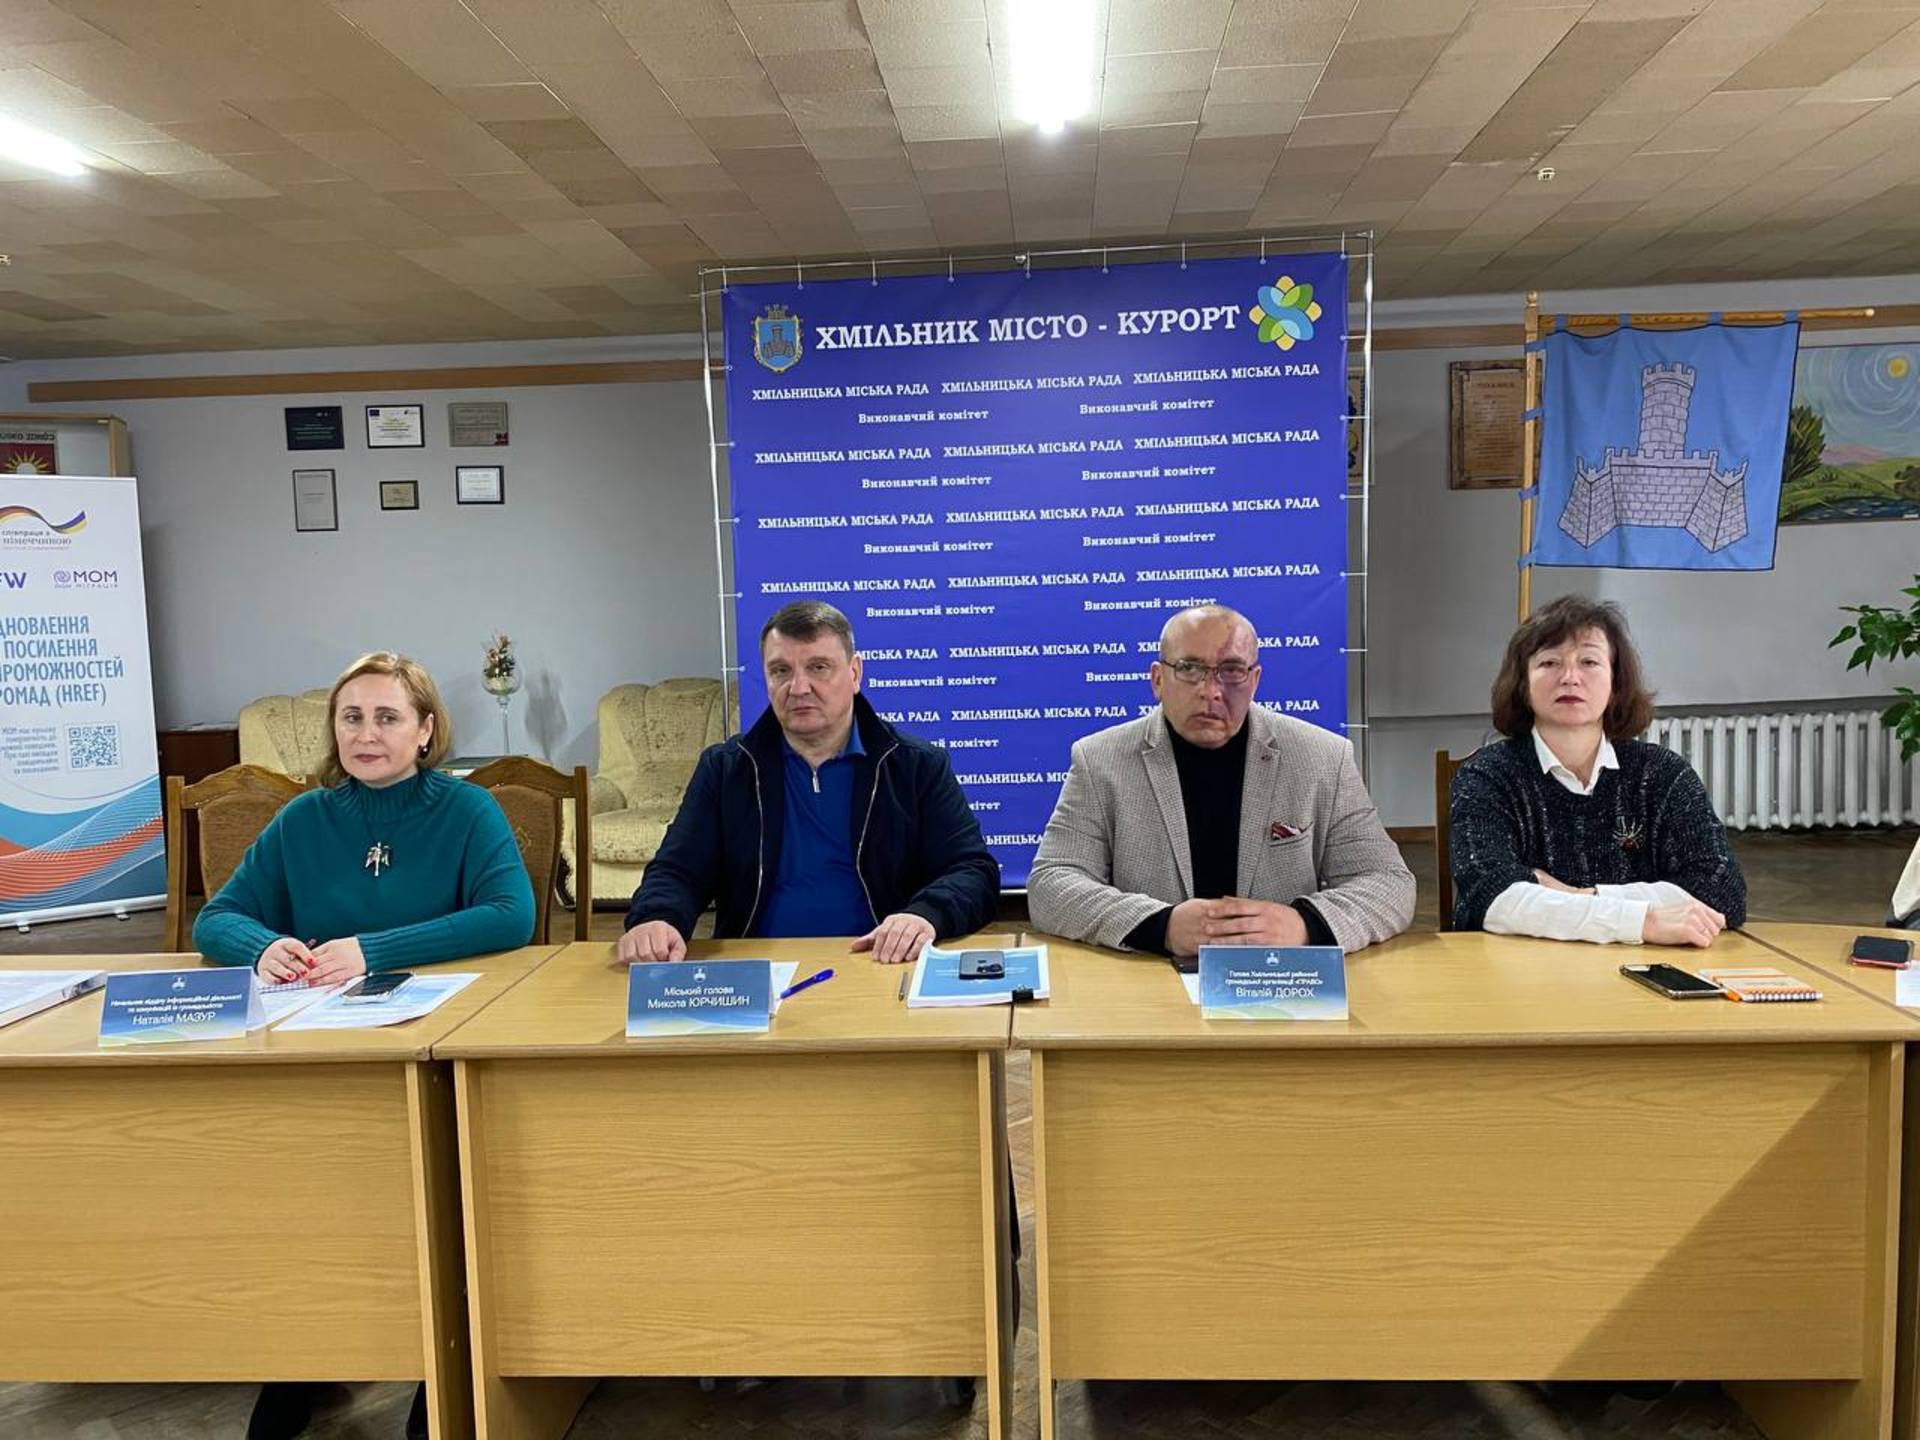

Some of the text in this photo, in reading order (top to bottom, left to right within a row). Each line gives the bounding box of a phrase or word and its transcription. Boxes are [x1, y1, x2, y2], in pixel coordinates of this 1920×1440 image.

[816, 320, 979, 349] ХМІЛЬНИК
[988, 315, 1087, 341] МІСТО
[1118, 305, 1240, 335] КУРОРТ
[1133, 364, 1319, 384] ХМІЛЬНИЦЬКА МІСЬКА РАДА
[942, 375, 1122, 393] ХМІЛЬНИЦЬКА МІСЬКА РАДА
[752, 384, 929, 400] ХМІЛЬНИЦЬКА МІСЬКА РАДА
[1080, 398, 1214, 414] Виконавчий комітет
[859, 409, 988, 423] Виконавчий комітет
[1134, 430, 1320, 449] ХМІЛЬНИЦЬКА МІСЬКА РАДА
[944, 440, 1123, 457] ХМІЛЬНИЦЬКА МІСЬКА РАДА
[755, 448, 931, 464] ХМІЛЬНИЦЬКА МІСЬКА РАДА
[1082, 465, 1216, 480] Виконавчий комітет
[862, 475, 991, 488] Виконавчий комітет
[1136, 497, 1320, 516] ХМІЛЬНИЦЬКА МІСЬКА РАДА
[758, 513, 933, 528] ХМІЛЬНИЦЬКА МІСЬКА РАДА
[946, 506, 1124, 523] ХМІЛЬНИЦЬКА МІСЬКА РАДА
[1083, 532, 1215, 546] Виконавчий комітет
[864, 541, 993, 553] Виконавчий комітет
[73, 571, 118, 583] МОМ
[1136, 564, 1320, 581] ХМІЛЬНИЦЬКА МІСЬКА РАДА
[0, 572, 27, 588] W
[761, 579, 936, 593] ХМІЛЬНИЦЬКА МІСЬКА РАДА
[948, 572, 1125, 588] ХМІЛЬНИЦЬКА МІСЬКА РАДА
[867, 604, 995, 617] Виконавчий комітет
[1084, 598, 1161, 610] Виконавчий
[4, 638, 98, 659] ПОСИЛЕННЯ
[1257, 635, 1320, 648] ЬКА РАДА
[905, 648, 938, 660] РАДА
[949, 645, 1040, 658] ХМІЛЬНИЦЬКА
[1042, 644, 1090, 655] МІСЬКА
[1093, 643, 1126, 654] РАДА
[0, 656, 124, 682] РОМОЖНОСТЕЙ
[869, 675, 997, 687] Виконавчий комітет
[1086, 672, 1152, 682] Виконавчи
[0, 683, 107, 708] ОМАД (HREF)
[1285, 700, 1320, 711] РАДА
[908, 710, 940, 723] РАДА
[952, 708, 1041, 720] ХМІЛЬНИЦЬКА
[1044, 707, 1091, 718] МІСЬКА
[1094, 706, 1127, 717] РАДА
[950, 737, 999, 748] комітет
[983, 834, 1043, 846] ЬНИЦЬКА
[664, 986, 734, 996] Міський голова
[1235, 987, 1315, 999] Віталій ДОРОХ
[648, 996, 750, 1009] Микола ЮРЧИШИН
[132, 1011, 216, 1026] Наталія МАЗУР
